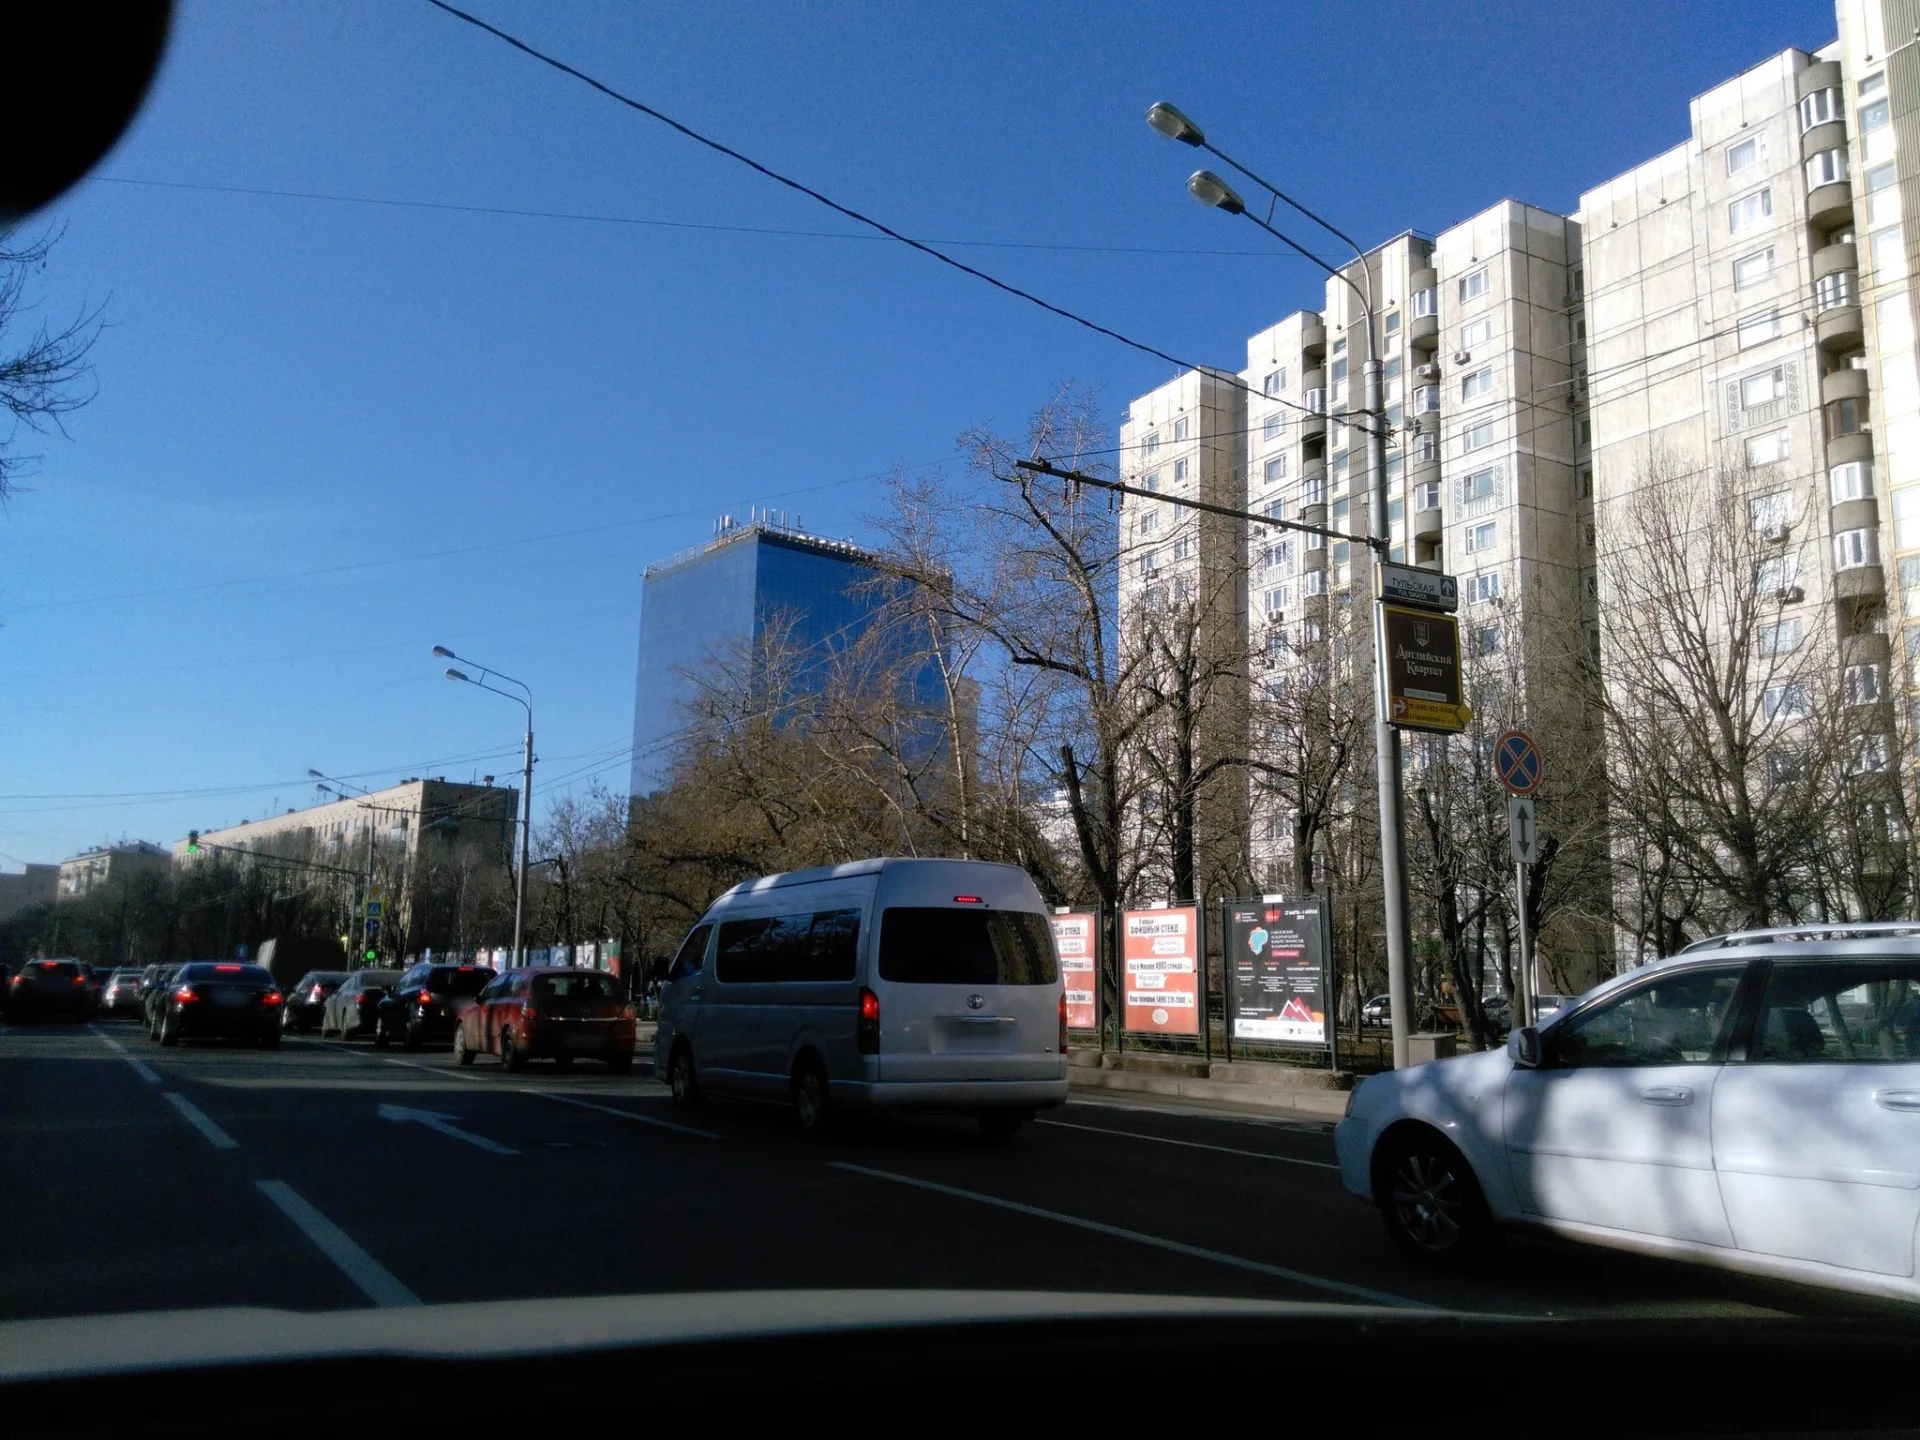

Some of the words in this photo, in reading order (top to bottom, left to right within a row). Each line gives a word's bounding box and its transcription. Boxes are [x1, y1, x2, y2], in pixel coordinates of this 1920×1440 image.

[1391, 577, 1435, 593] ТУЛЬСКАЯ
[1396, 644, 1452, 664] Английский
[1406, 660, 1442, 677] Квартал
[1160, 924, 1179, 933] СТЕНД
